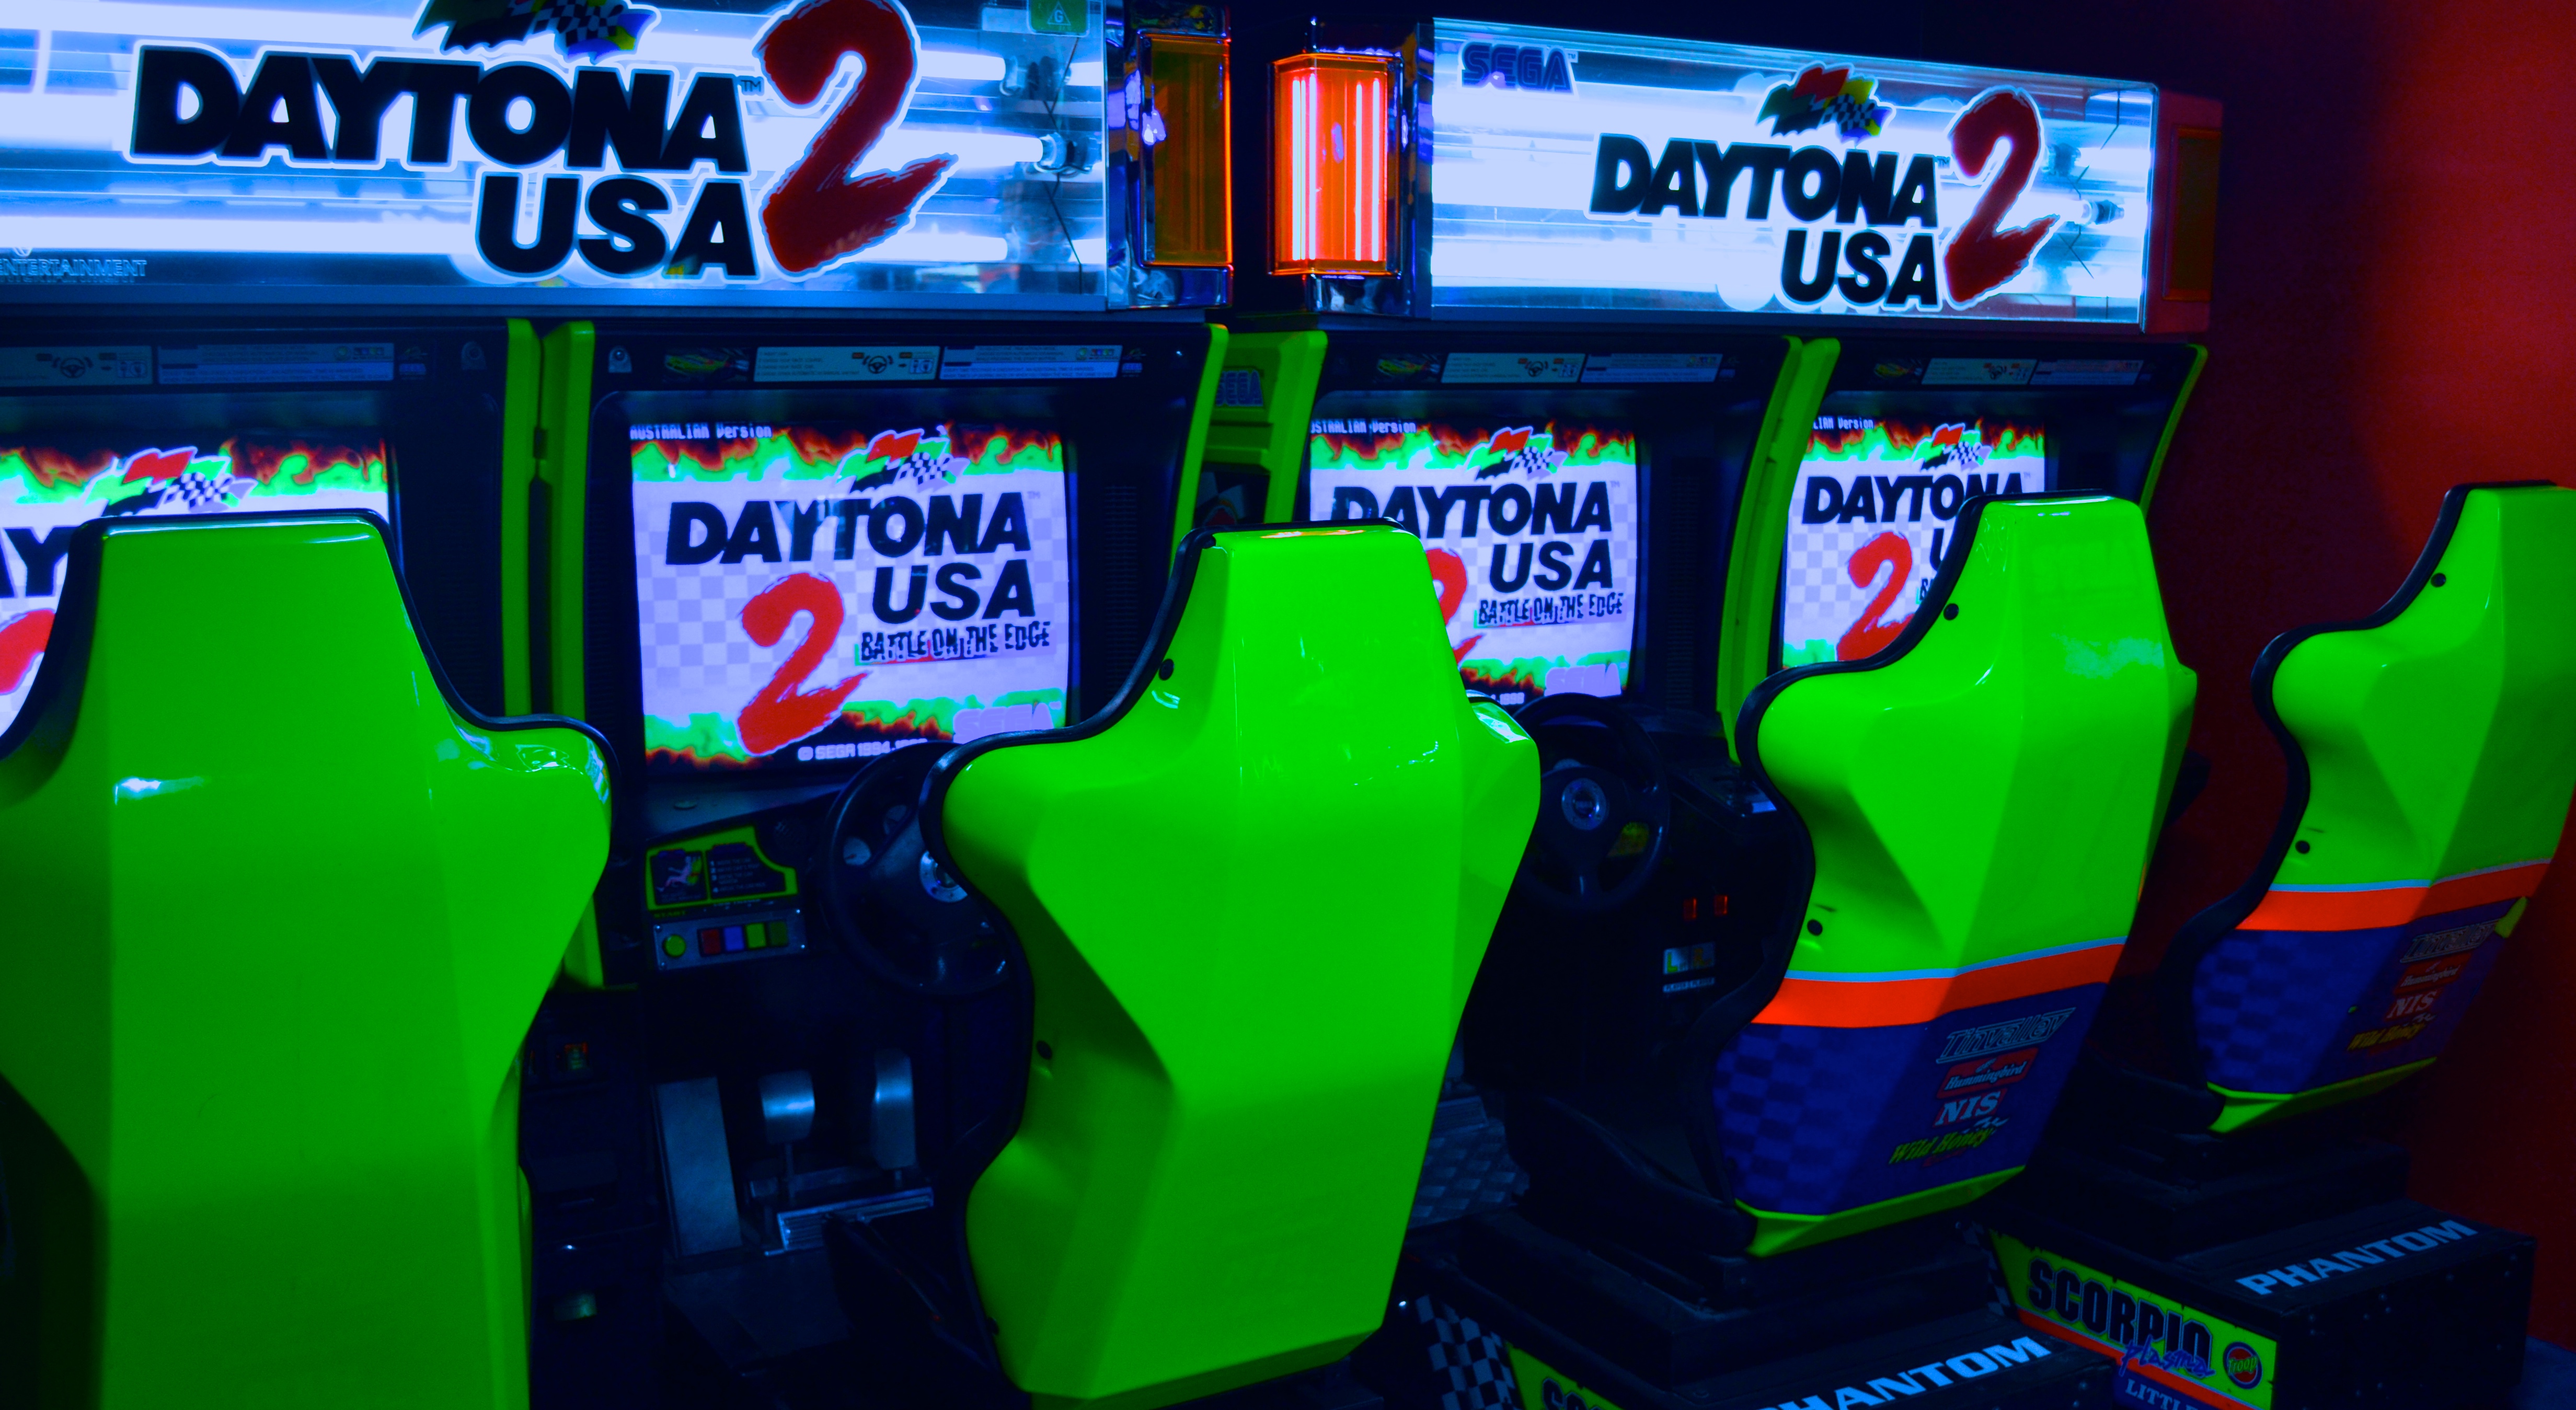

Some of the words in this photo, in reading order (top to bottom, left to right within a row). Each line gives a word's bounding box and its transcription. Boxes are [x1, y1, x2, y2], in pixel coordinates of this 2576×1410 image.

[1462, 42, 1573, 94] SEGA
[132, 47, 750, 174] DAYTONA
[753, 0, 957, 274] 2
[1589, 133, 1938, 227] DAYTONA
[1945, 92, 2060, 303] 2
[476, 175, 758, 277] USA
[0, 258, 147, 276] NTERTAINMENT
[1780, 229, 1939, 305] USA
[1310, 419, 1366, 434] STRALIAN
[666, 492, 1031, 565] DAYTONA
[1330, 481, 1612, 538] DAYTONA
[872, 559, 1036, 624] USA
[1489, 539, 1613, 593] USA
[1836, 531, 1916, 662] 2
[861, 630, 927, 661] BATTLE
[932, 628, 959, 657] ON
[965, 623, 998, 656] THE
[1004, 620, 1051, 651] EDGE
[1479, 598, 1530, 625] BATTLE
[1534, 597, 1554, 621] ON
[1559, 594, 1583, 621] THE
[1589, 592, 1624, 618] EDGE
[738, 573, 872, 757] 2
[815, 743, 856, 760] SEGA
[2386, 991, 2438, 1019] NIS
[1934, 1091, 2002, 1126] NIS
[2235, 1219, 2479, 1296] PHANTOM
[2028, 1257, 2214, 1368] SCORPIO
[1762, 1336, 2052, 1410] HANTOM
